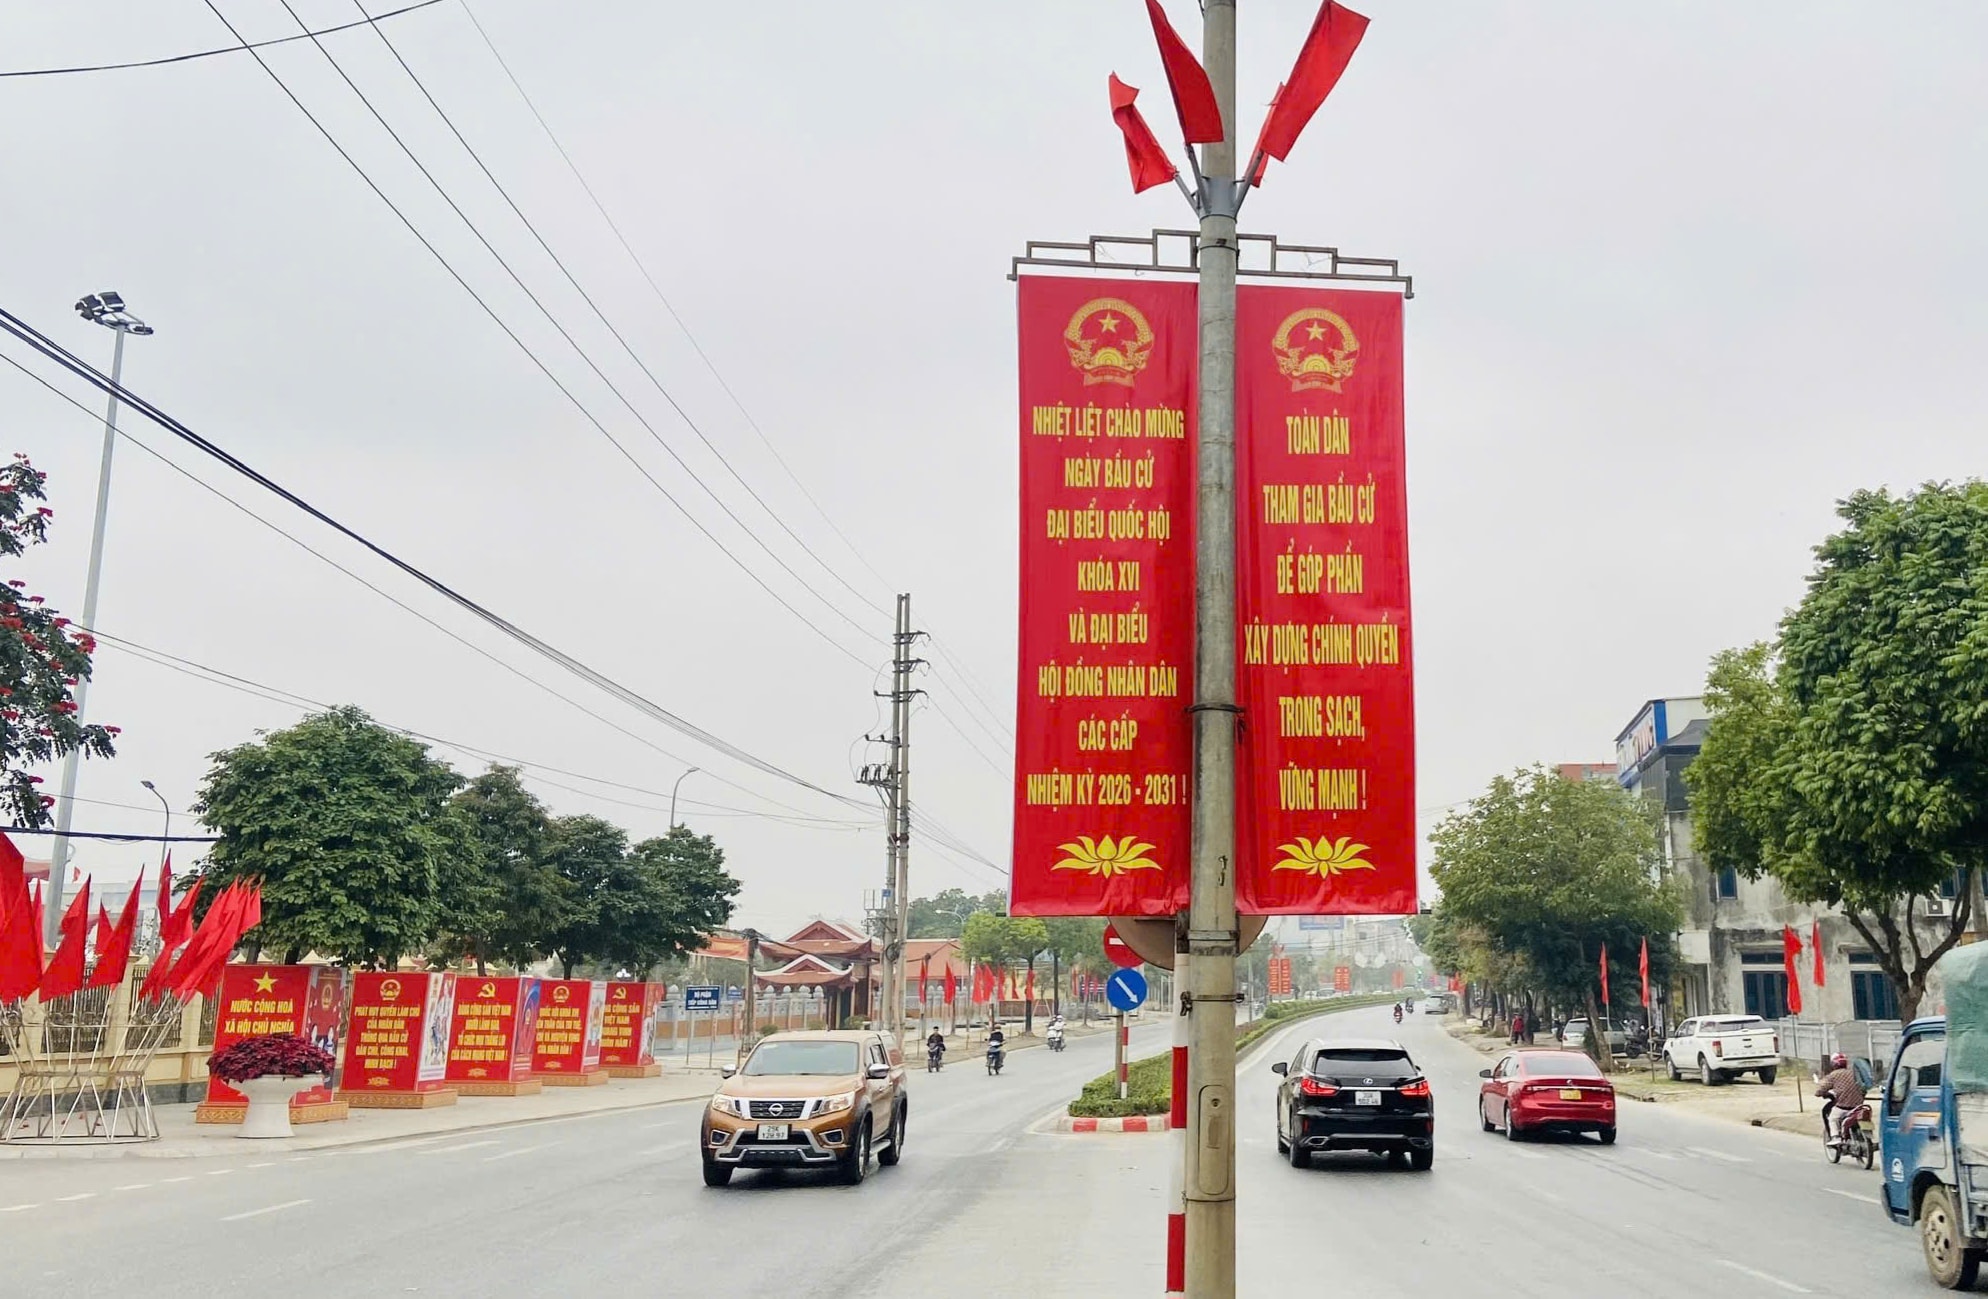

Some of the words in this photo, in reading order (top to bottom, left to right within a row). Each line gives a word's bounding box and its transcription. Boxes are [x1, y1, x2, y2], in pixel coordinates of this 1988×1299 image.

[1033, 401, 1071, 441] NHIỆT
[1075, 402, 1102, 442] LIỆT
[1106, 403, 1141, 438] CHÀO
[1145, 404, 1184, 438] MỪNG
[1286, 408, 1320, 454] TOÀN
[1323, 409, 1350, 454] DÂN
[1065, 453, 1101, 487] NGÀY
[1105, 449, 1131, 488] BẦU
[1135, 449, 1154, 488] CỬ
[1263, 485, 1299, 523] THAM
[1303, 485, 1325, 524] GIA
[1328, 471, 1354, 523] BẦU
[1357, 473, 1375, 524] CỬ
[1047, 509, 1069, 544] ĐẠI
[1074, 498, 1104, 538] BIỂU
[1109, 500, 1144, 542] QUỐC
[1148, 505, 1169, 545] HỘI
[1078, 555, 1114, 591] KHÓA
[1118, 562, 1139, 591] XVI
[1277, 538, 1294, 593] ĐỂ
[1298, 546, 1323, 593] GÓP
[1327, 540, 1362, 593] PHẦN
[1069, 608, 1086, 643] VÀ
[1090, 614, 1112, 650] ĐẠI
[1117, 602, 1147, 643] BIỂU
[1245, 617, 1268, 664] XÂY
[1273, 621, 1308, 674] DỰNG
[1312, 616, 1352, 664] CHÍNH
[1356, 612, 1398, 667] QUYỀN
[1039, 660, 1061, 702] HỘI
[1065, 657, 1103, 696] ĐỒNG
[1108, 660, 1145, 696] NHÂN
[1150, 661, 1176, 696] DÂN
[1079, 715, 1106, 750] CÁC
[1110, 710, 1137, 750] CẤP
[1279, 696, 1322, 736] TRONG
[1326, 696, 1364, 745] SẠCH,
[1028, 768, 1072, 811] NHIỆM
[1077, 768, 1094, 804] KỲ
[1098, 774, 1131, 804] 2026
[1145, 775, 1175, 804] 2031
[1279, 762, 1314, 810] VỮNG
[1318, 769, 1357, 819] MẠNH
[237, 1019, 251, 1037] HỘI
[252, 1018, 269, 1034] CHỦ
[254, 998, 276, 1016] CỘNG
